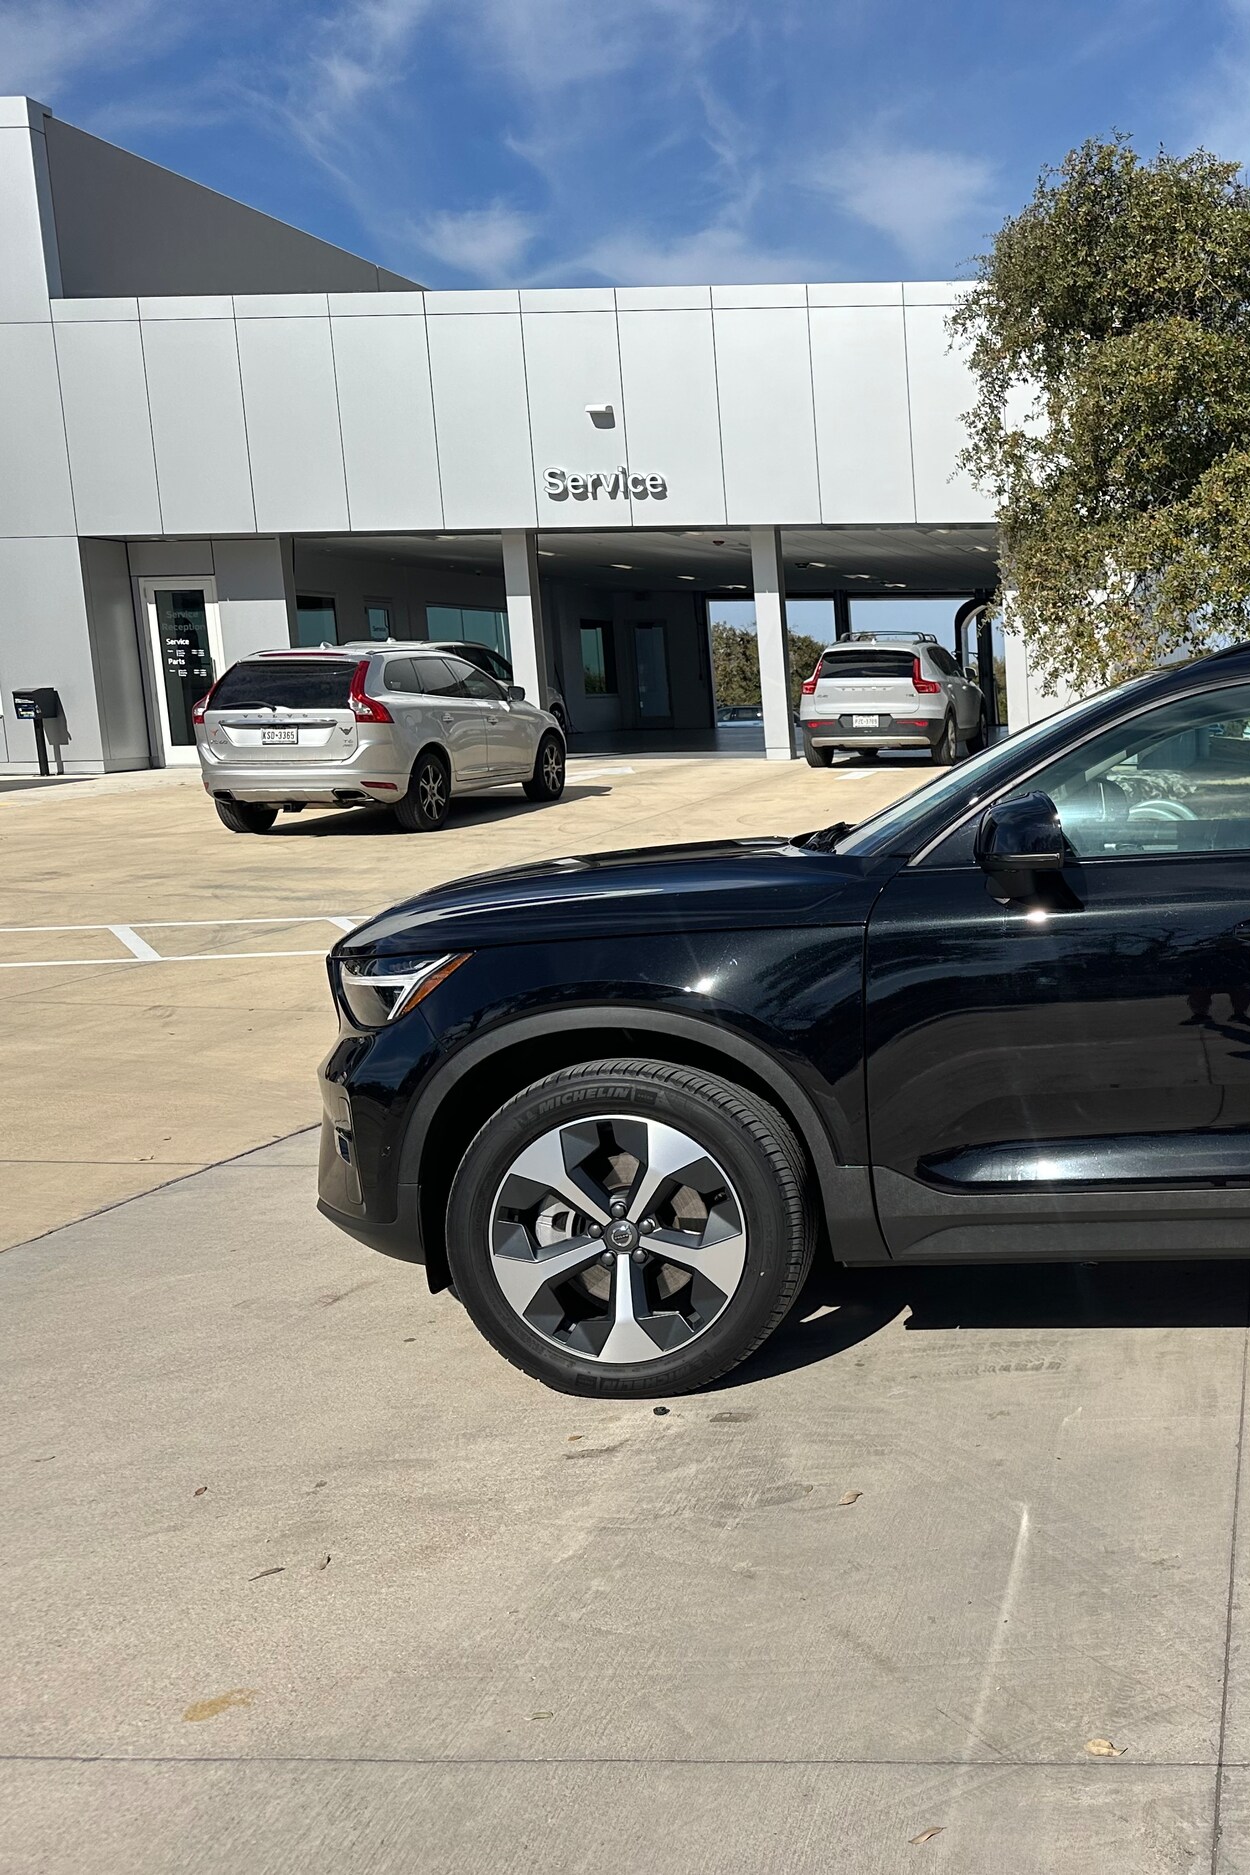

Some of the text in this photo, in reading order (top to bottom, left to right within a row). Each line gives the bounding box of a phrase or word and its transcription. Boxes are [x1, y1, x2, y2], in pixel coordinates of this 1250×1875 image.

[543, 465, 665, 496] Service
[166, 610, 199, 619] Service
[161, 622, 206, 632] Reception
[166, 638, 190, 646] Service
[539, 1086, 630, 1114] MICHELIN
